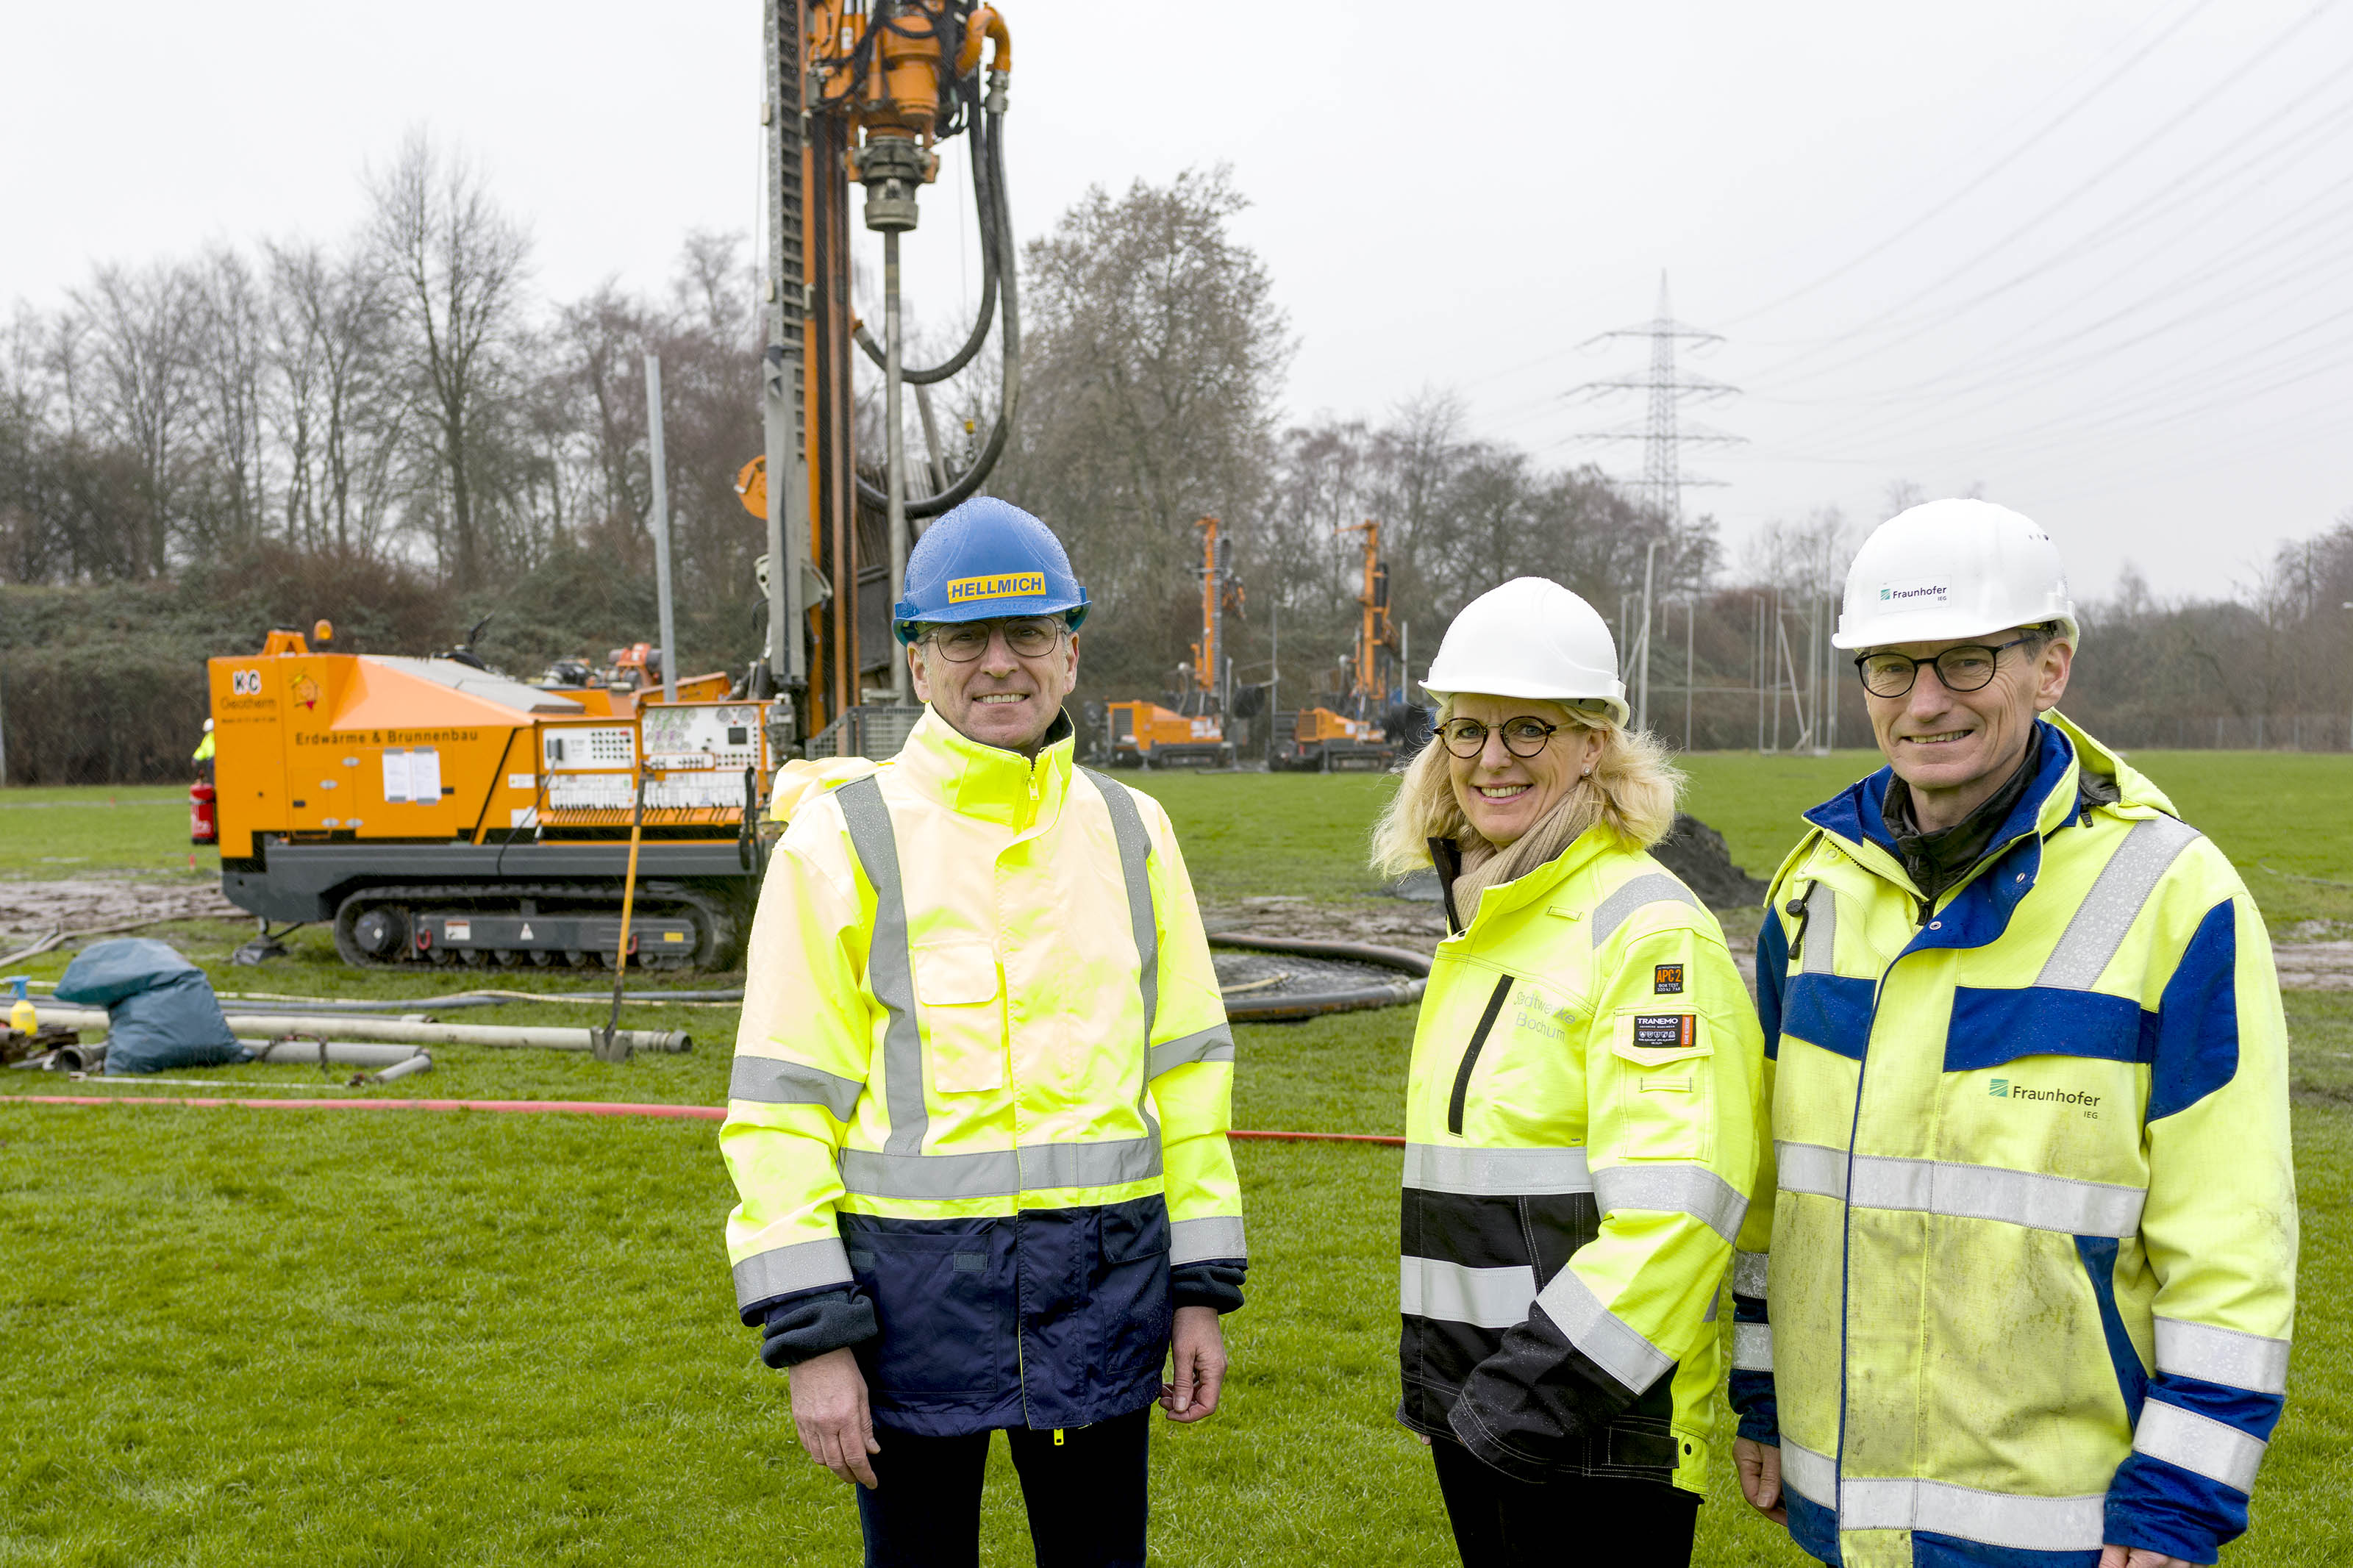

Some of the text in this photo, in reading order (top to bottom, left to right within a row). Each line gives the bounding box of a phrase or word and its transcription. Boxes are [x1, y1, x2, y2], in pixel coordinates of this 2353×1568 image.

[951, 578, 1042, 598] HELLMICH
[1893, 586, 1947, 599] Fraunhofer
[296, 729, 478, 745] Erdwärme & Brunnenbau
[1657, 969, 1682, 982] APC 2
[1513, 992, 1576, 1024] Sadtwerke
[1516, 1012, 1565, 1042] Bochum
[2013, 1086, 2101, 1106] Fraunhofer
[2083, 1111, 2099, 1119] IEG
